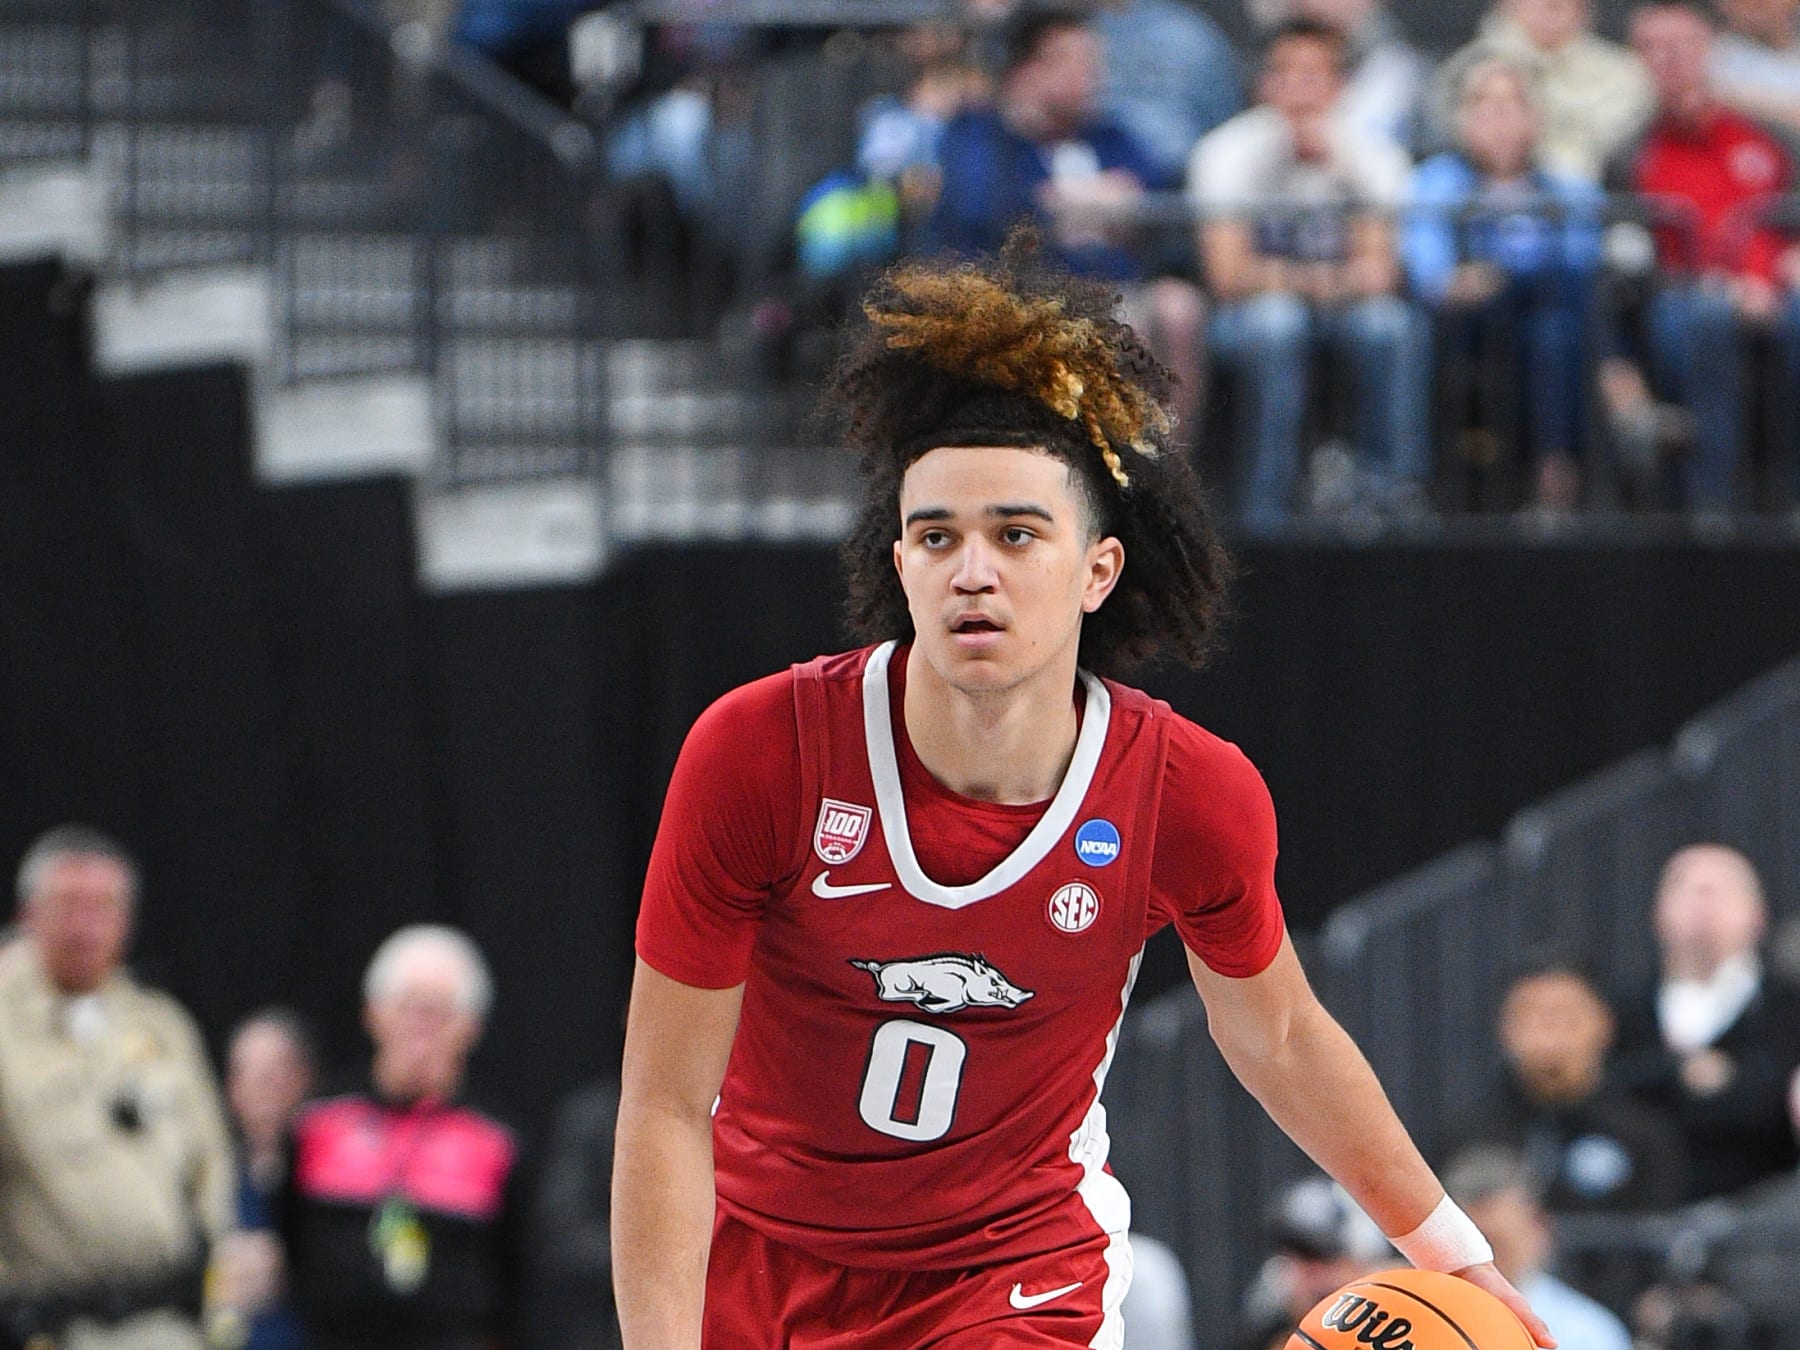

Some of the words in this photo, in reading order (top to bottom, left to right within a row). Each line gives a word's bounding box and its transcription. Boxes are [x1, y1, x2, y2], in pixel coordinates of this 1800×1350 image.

[824, 811, 863, 837] 100
[1080, 840, 1118, 855] NCAA
[1053, 886, 1095, 929] SEC
[859, 1019, 967, 1142] 0
